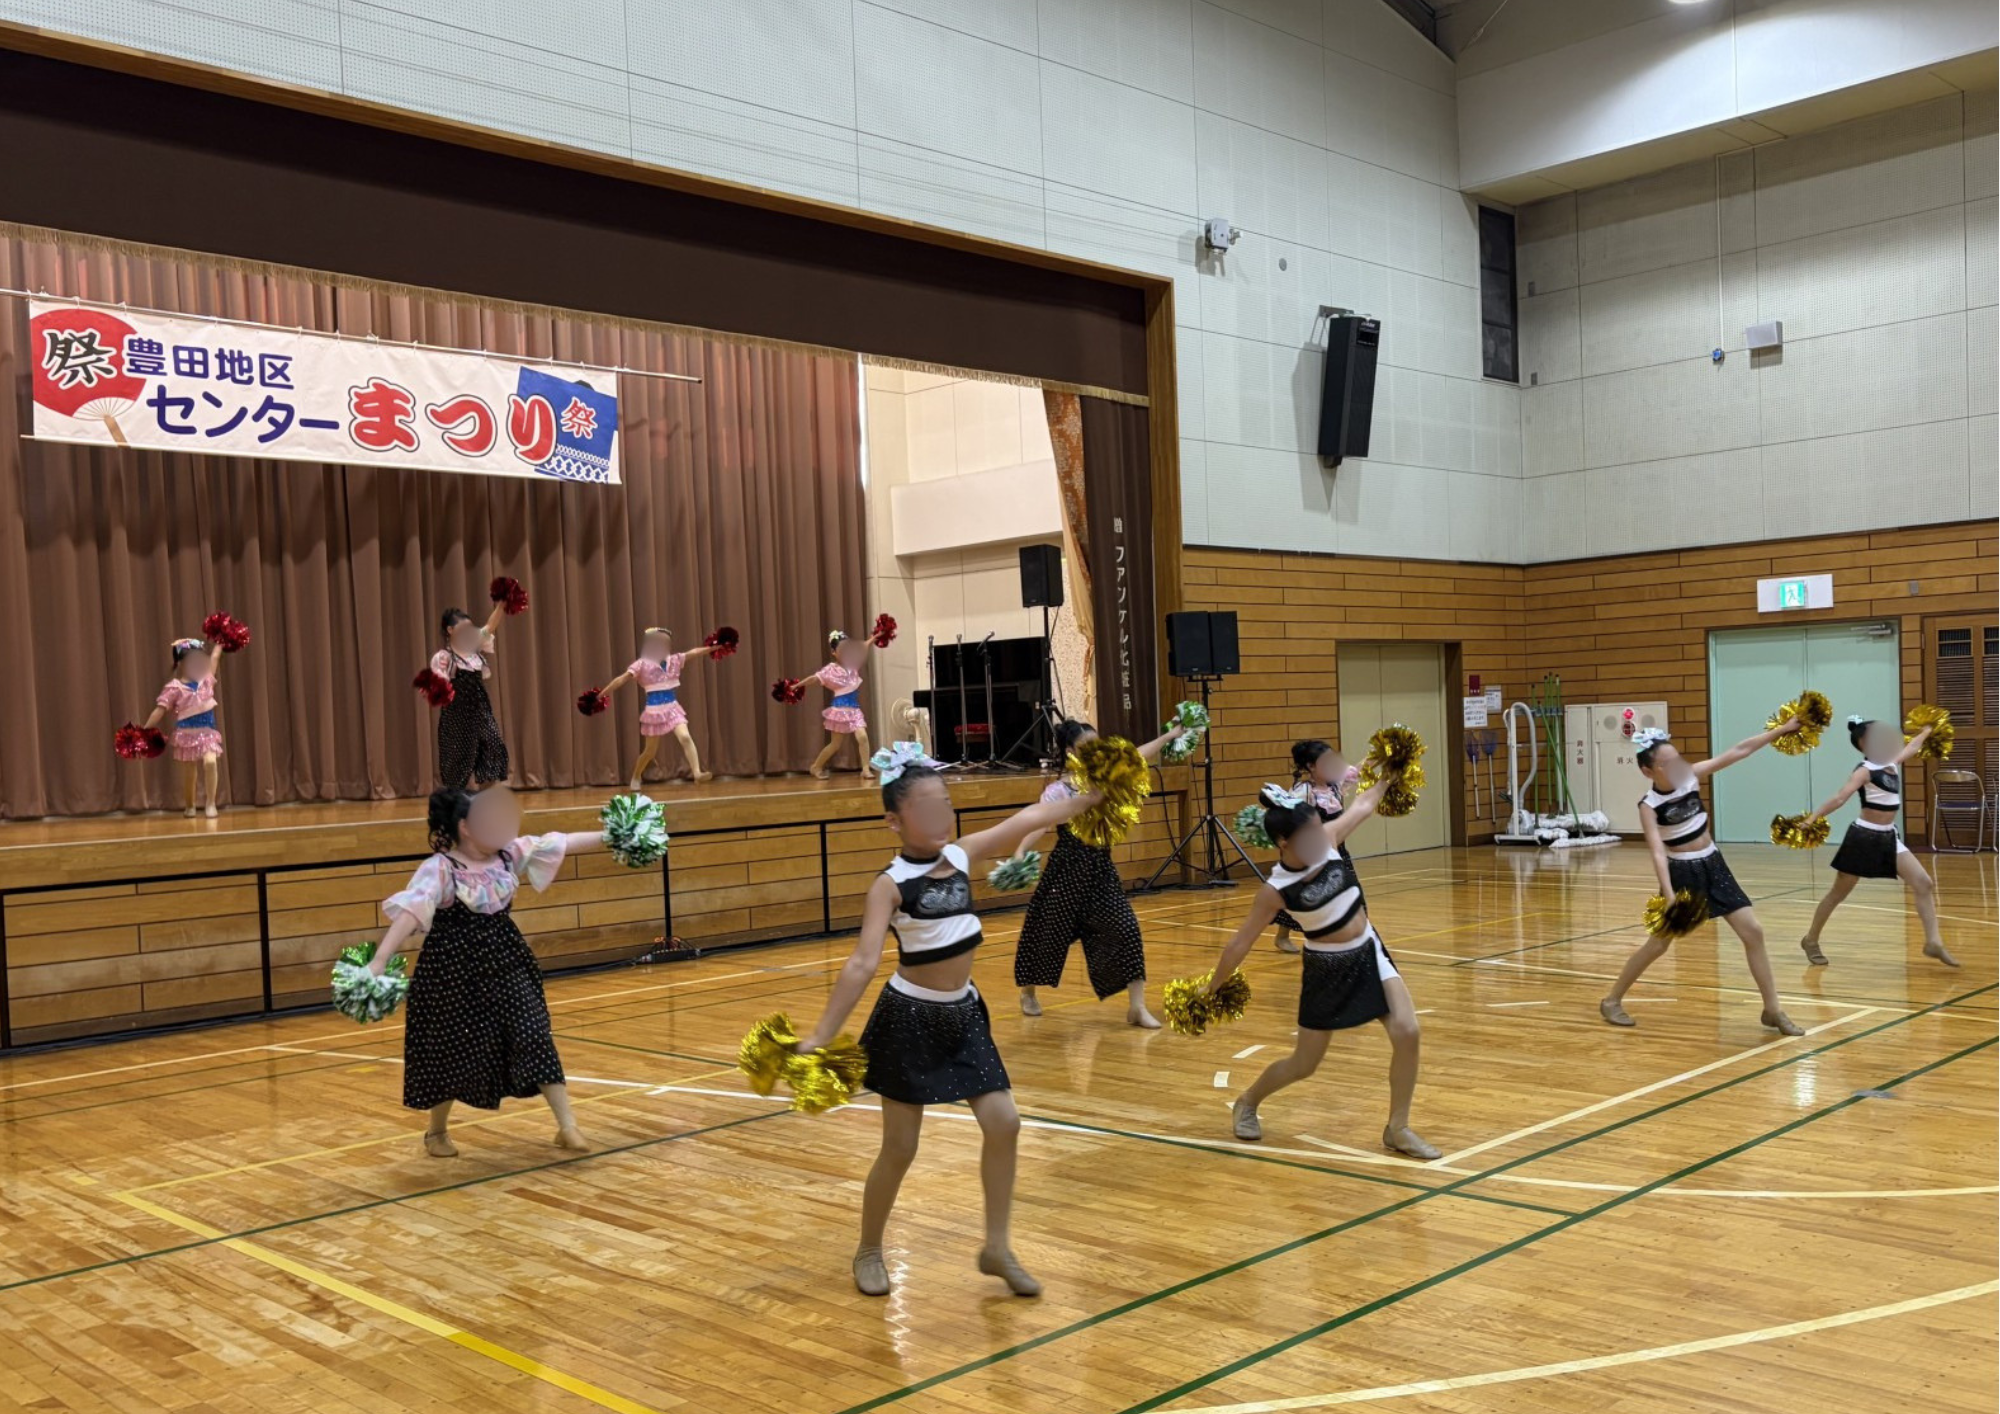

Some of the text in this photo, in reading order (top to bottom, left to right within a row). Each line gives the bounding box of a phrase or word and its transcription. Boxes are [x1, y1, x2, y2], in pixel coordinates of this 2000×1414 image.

[43, 329, 117, 388] 祭
[125, 337, 295, 390] 豊田地区
[146, 377, 557, 465] センター まつり
[560, 396, 599, 440] 祭
